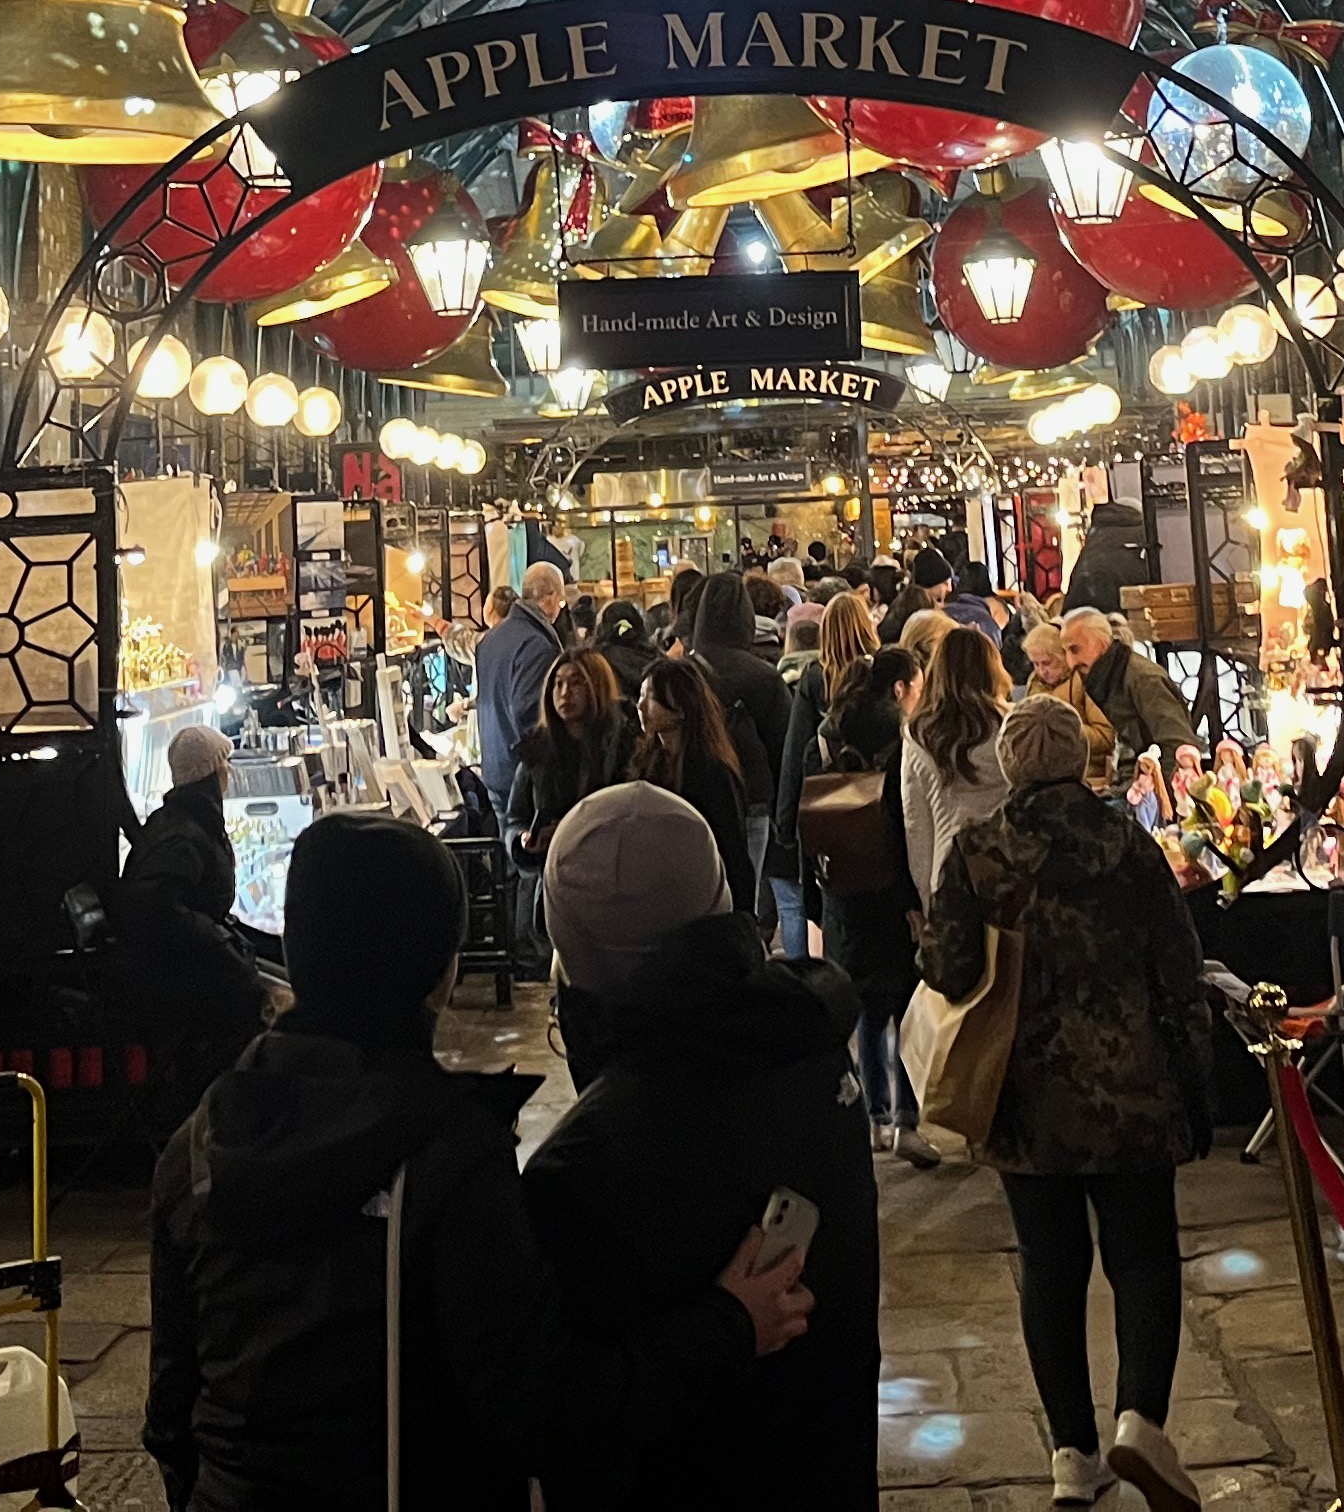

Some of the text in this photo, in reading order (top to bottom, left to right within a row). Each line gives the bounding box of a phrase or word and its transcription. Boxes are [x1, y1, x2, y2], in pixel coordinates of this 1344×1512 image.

[378, 10, 1030, 131] APPLE MARKET
[581, 305, 839, 334] Hand-made Art & Design
[642, 367, 881, 410] APPLE MARKET
[713, 472, 804, 484] Hand-made Art & Design
